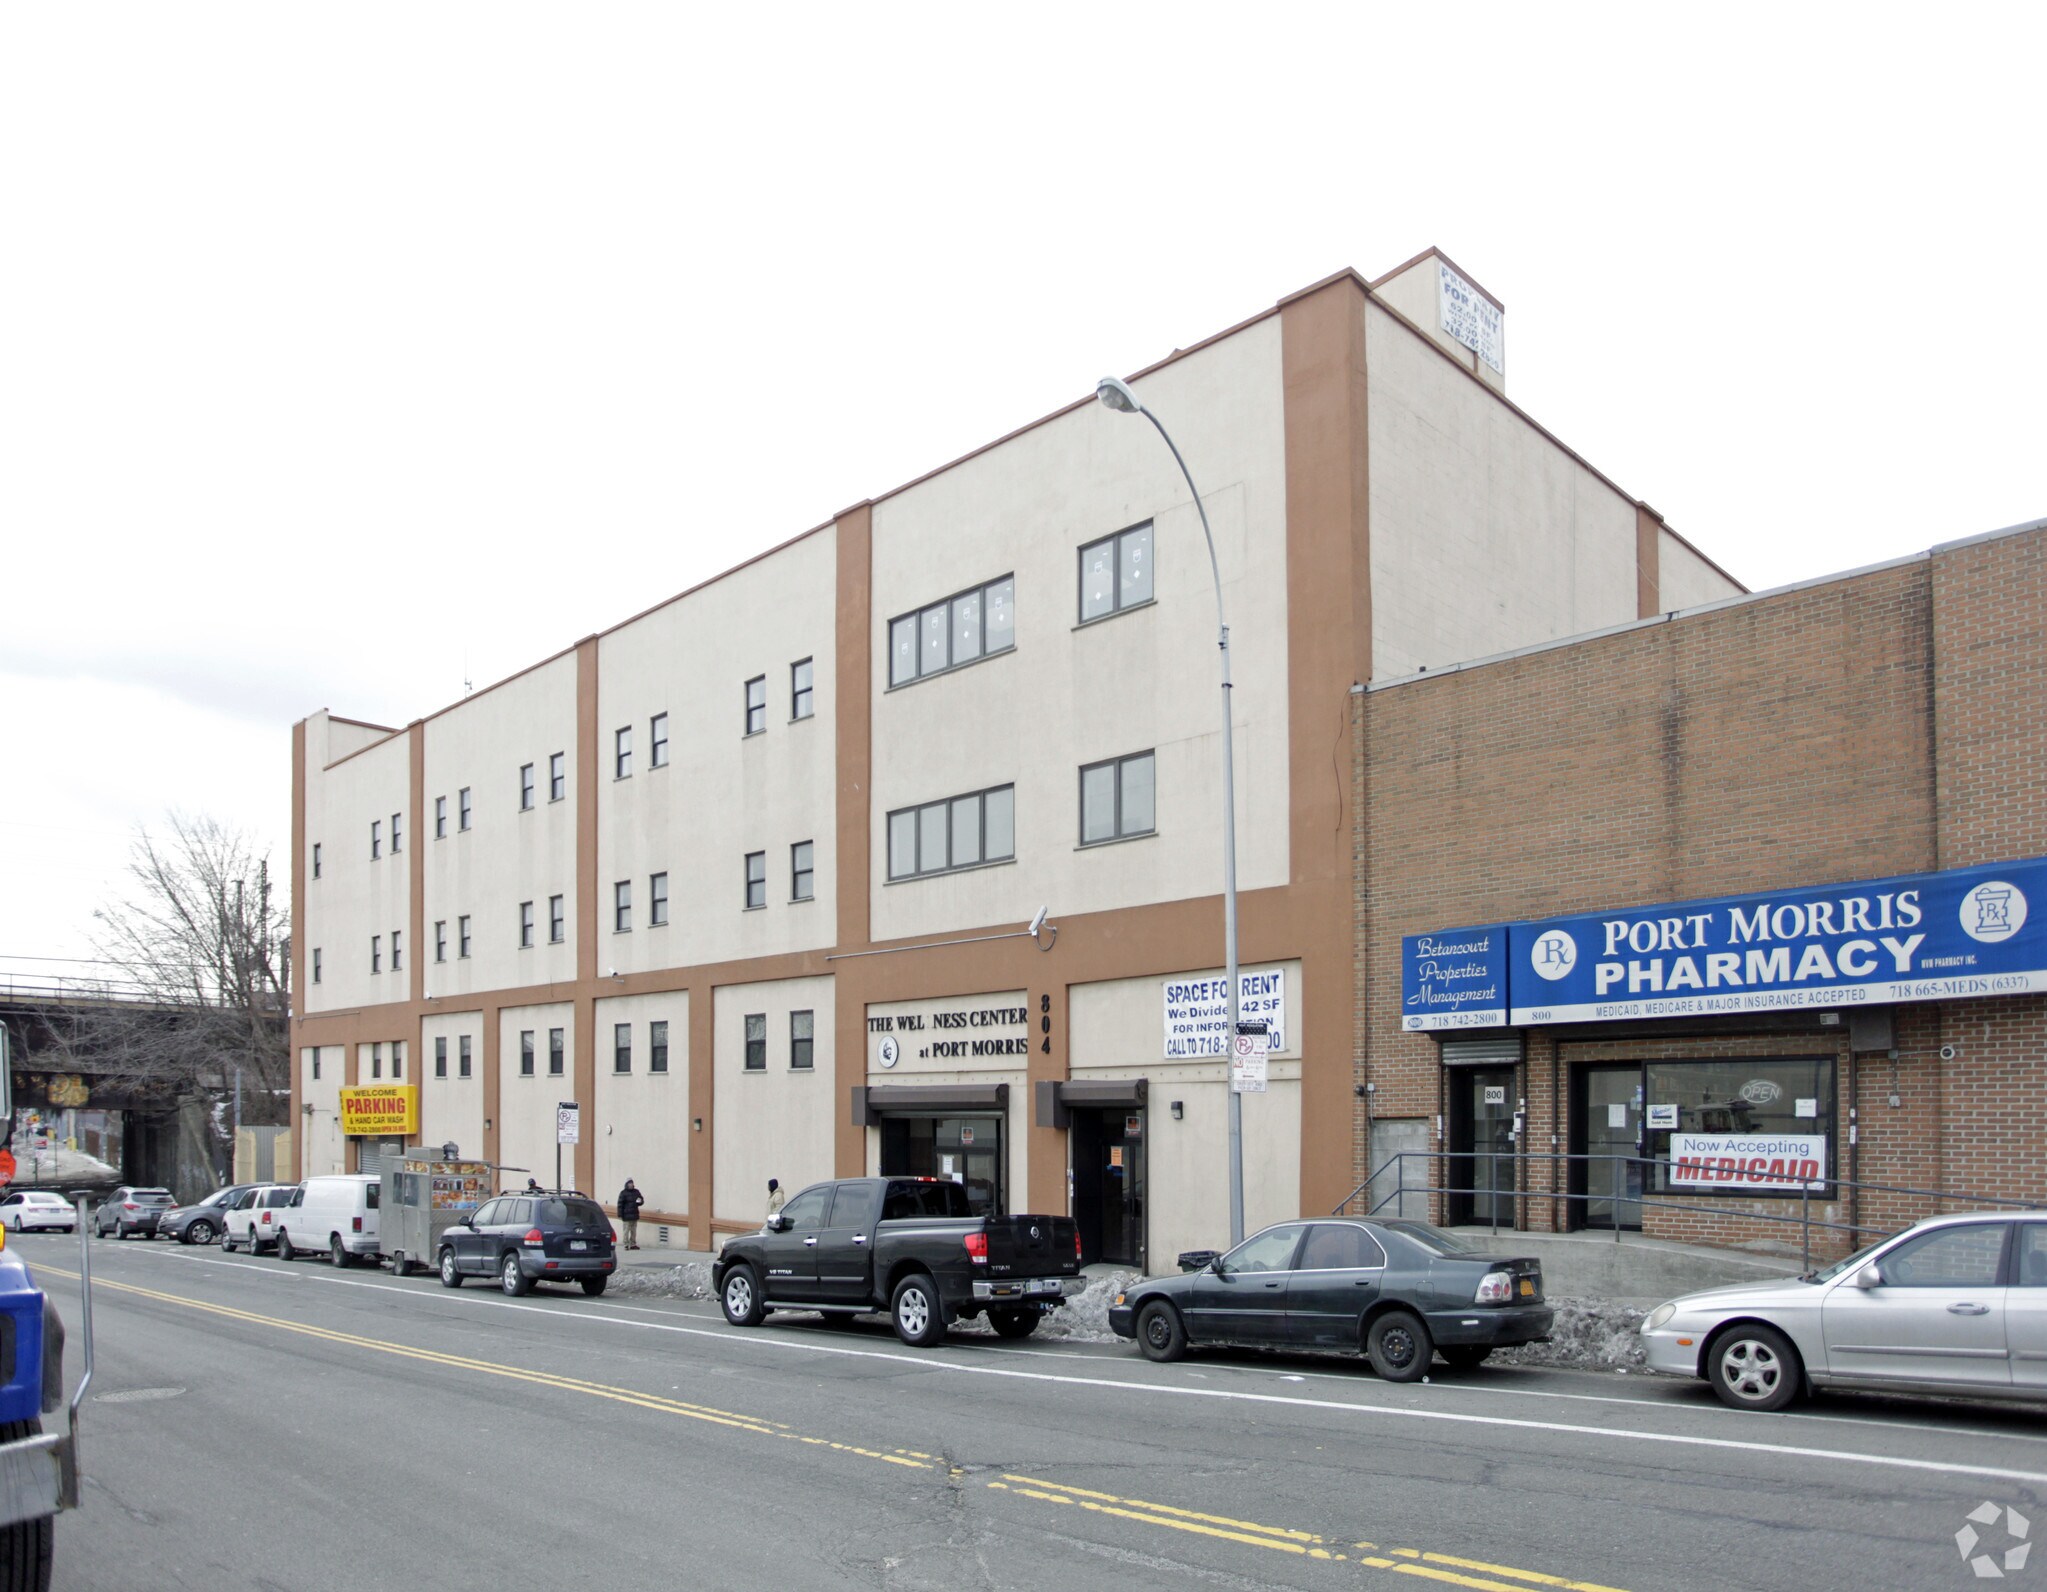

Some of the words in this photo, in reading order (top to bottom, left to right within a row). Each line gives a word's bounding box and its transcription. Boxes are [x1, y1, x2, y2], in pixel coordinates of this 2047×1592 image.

[1444, 283, 1469, 305] FOR
[1603, 913, 1713, 956] PORT
[1727, 890, 1922, 944] MORRIS
[1416, 936, 1489, 958] Betancourt
[1595, 933, 1927, 995] PHARMACY
[1935, 955, 1964, 968] PHARMACY
[1965, 954, 1978, 966] INC.
[1419, 960, 1487, 987] Properties
[1167, 982, 1208, 1003] SPACE
[1242, 974, 1280, 996] RENT
[1890, 984, 1911, 998] 718
[1915, 978, 1988, 996] 665-MEDS
[1992, 975, 2029, 991] (6337)
[1407, 984, 1496, 1010] Management
[1596, 1003, 1642, 1017] MEDICAID,
[1645, 1000, 1693, 1014] MEDICARE
[1697, 1000, 1703, 1011] &
[1706, 996, 1740, 1010] MAJOR
[1744, 992, 1803, 1007] INSURANCE
[1808, 988, 1866, 1004] ACCEPTED
[1168, 1008, 1187, 1019] We
[1263, 999, 1280, 1010] SF
[1532, 1011, 1551, 1021] 800
[868, 1016, 893, 1032] THE
[970, 1007, 1028, 1027] CENTER
[1173, 1023, 1193, 1034] FOR
[1432, 1016, 1449, 1027] 718
[1452, 1012, 1498, 1026] 742-2800
[919, 1047, 929, 1058] at
[933, 1041, 968, 1057] PORT
[972, 1038, 1028, 1056] MORRIS
[1168, 1038, 1186, 1055] CALL
[1188, 1039, 1196, 1055] TO
[353, 1089, 397, 1097] WELCOME
[1486, 1090, 1502, 1099] 800
[1741, 1085, 1780, 1100] OPEN
[346, 1097, 406, 1114] PARKING
[373, 1116, 385, 1124] CAR
[387, 1115, 404, 1123] WASH
[1684, 1138, 1720, 1152] Now
[1724, 1140, 1810, 1156] Accepting
[1675, 1156, 1819, 1184] MEDICAID
